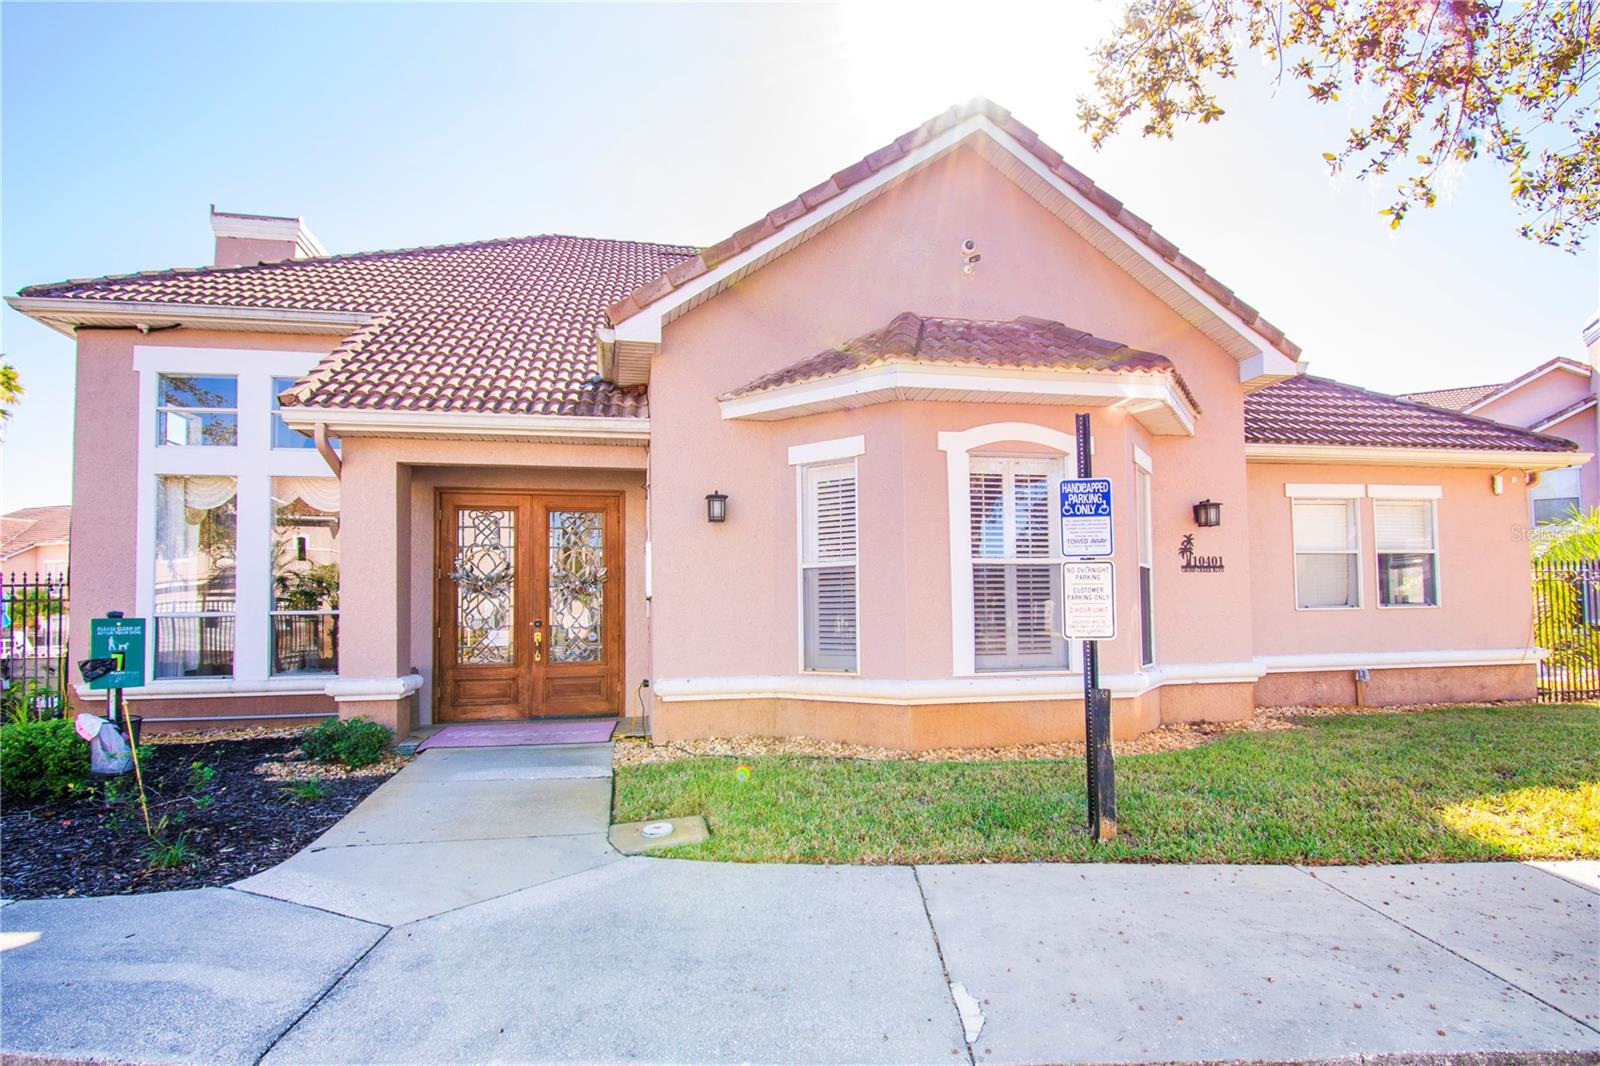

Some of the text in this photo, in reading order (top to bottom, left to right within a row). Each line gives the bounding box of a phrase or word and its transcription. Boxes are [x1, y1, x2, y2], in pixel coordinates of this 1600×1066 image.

[1062, 482, 1108, 493] HANDICAPPED
[1068, 493, 1102, 504] PARKING
[1075, 505, 1096, 514] ONLY
[1193, 556, 1223, 567] 10401
